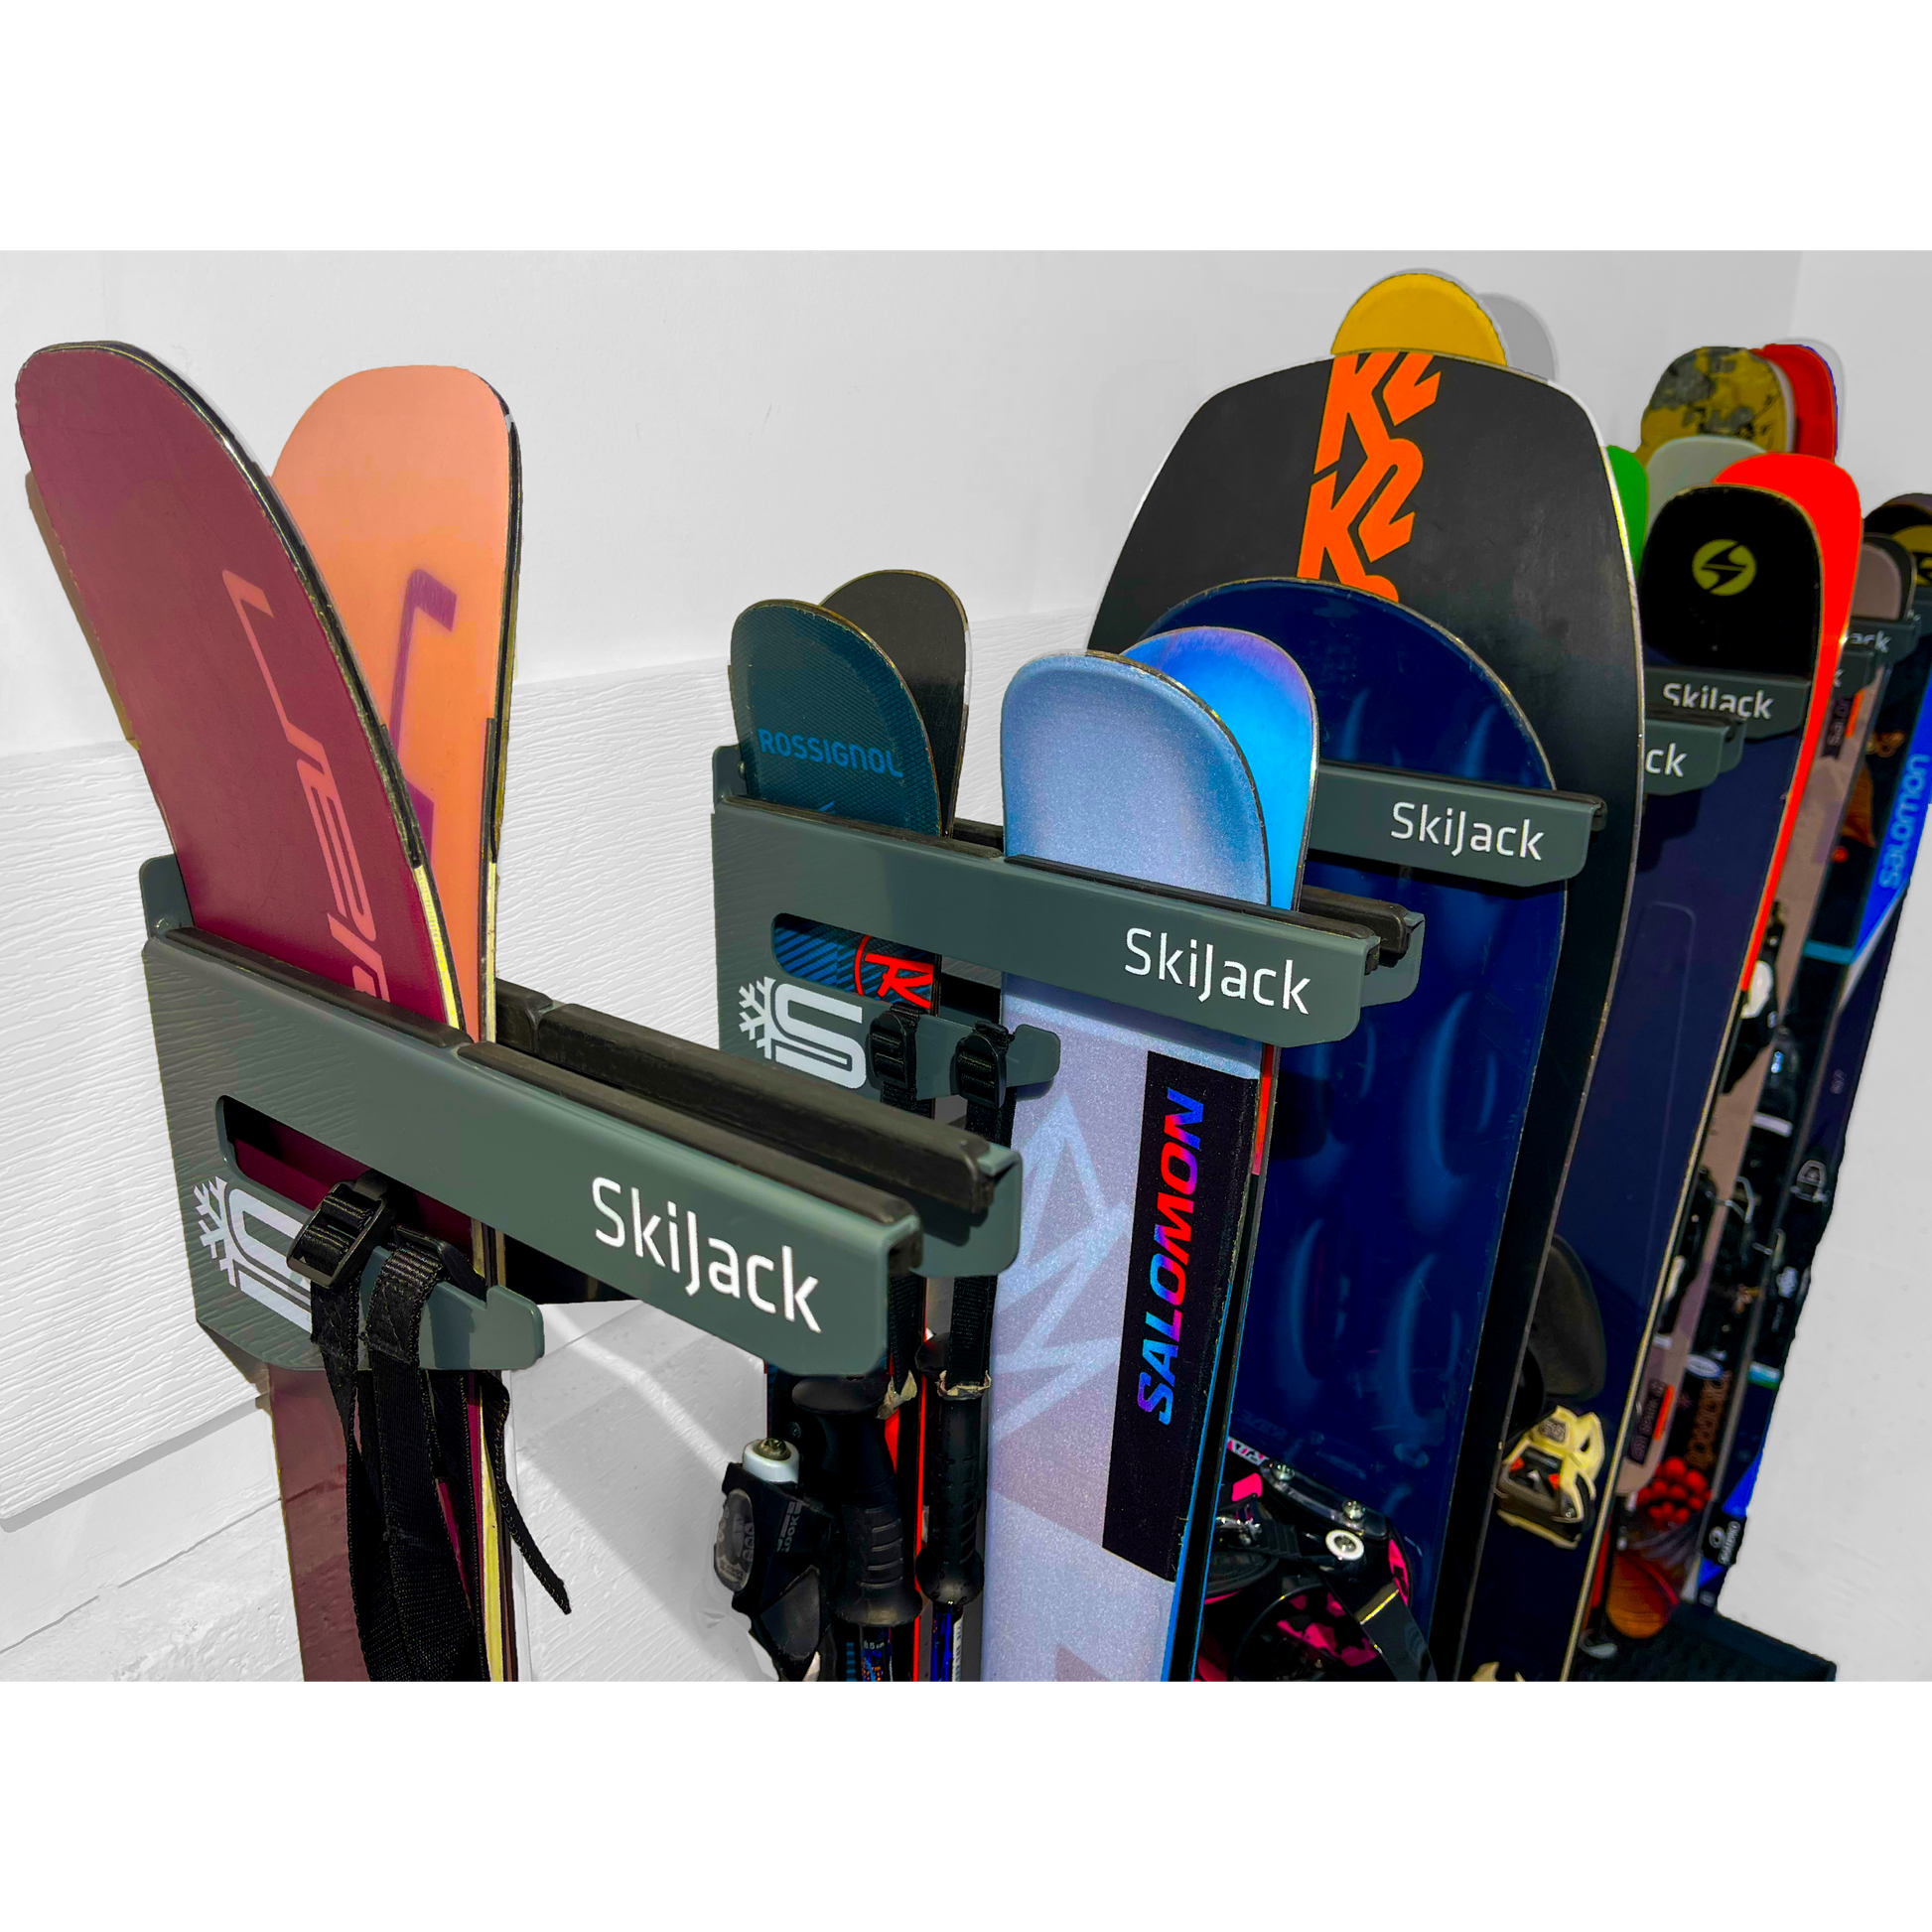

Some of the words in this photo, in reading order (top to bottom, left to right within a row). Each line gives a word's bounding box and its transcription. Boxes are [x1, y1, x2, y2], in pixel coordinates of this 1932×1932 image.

[757, 728, 904, 779] ROSSIGNOL
[1390, 800, 1545, 862] SkiJack
[1124, 927, 1311, 1016] SkiJack
[592, 1176, 821, 1334] SkiJack
[1138, 1088, 1205, 1428] SALOMON
